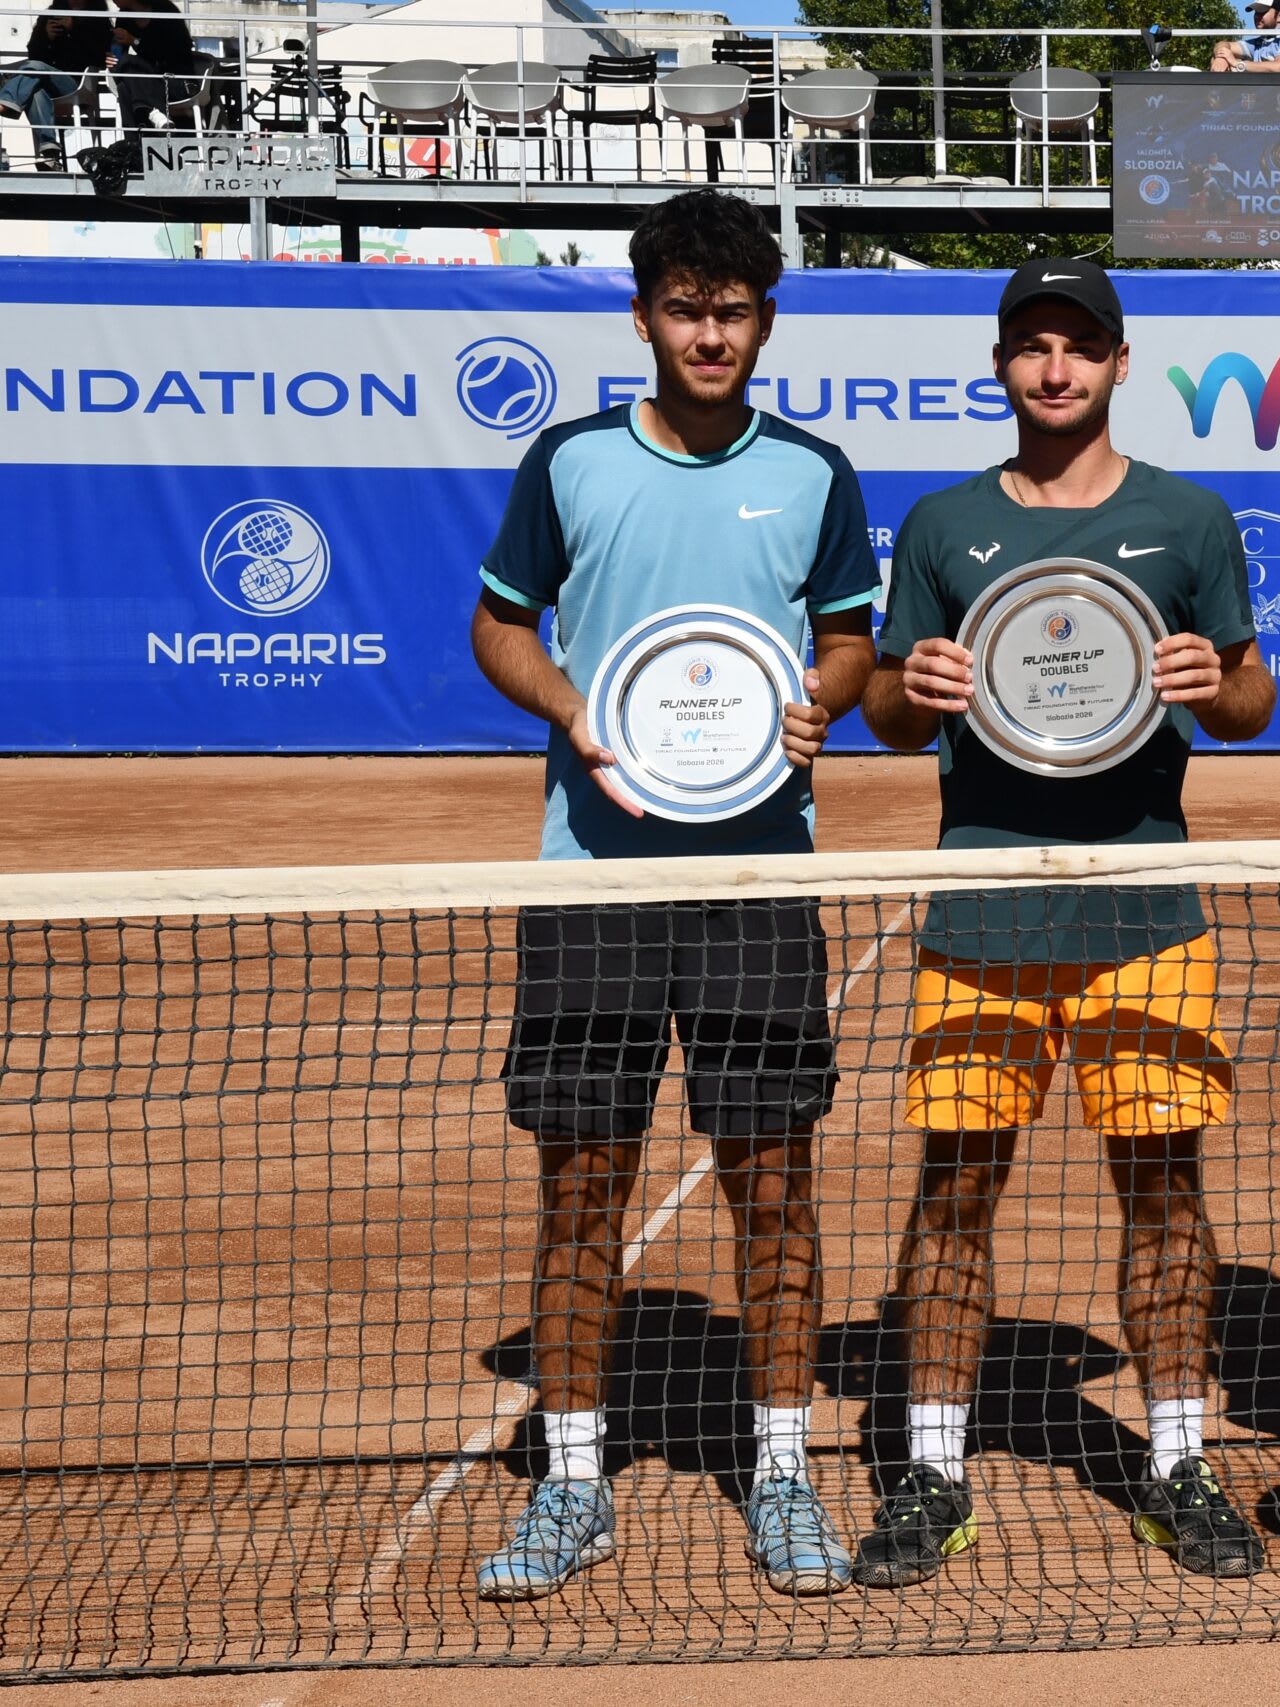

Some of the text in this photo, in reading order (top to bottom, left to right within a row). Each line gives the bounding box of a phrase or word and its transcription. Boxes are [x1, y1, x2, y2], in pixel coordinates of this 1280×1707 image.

[1124, 160, 1184, 170] SLOBOZIA
[204, 179, 283, 191] TROPHY
[5, 368, 417, 417] NDATION
[148, 633, 387, 665] NAPARIS
[1022, 649, 1104, 666] RUNNER UP
[1040, 663, 1089, 676] DOUBLES
[219, 673, 323, 688] TROPHY
[659, 698, 743, 709] RUNNER UP
[676, 711, 725, 721] DOUBLES
[1046, 713, 1074, 721] Slobozia
